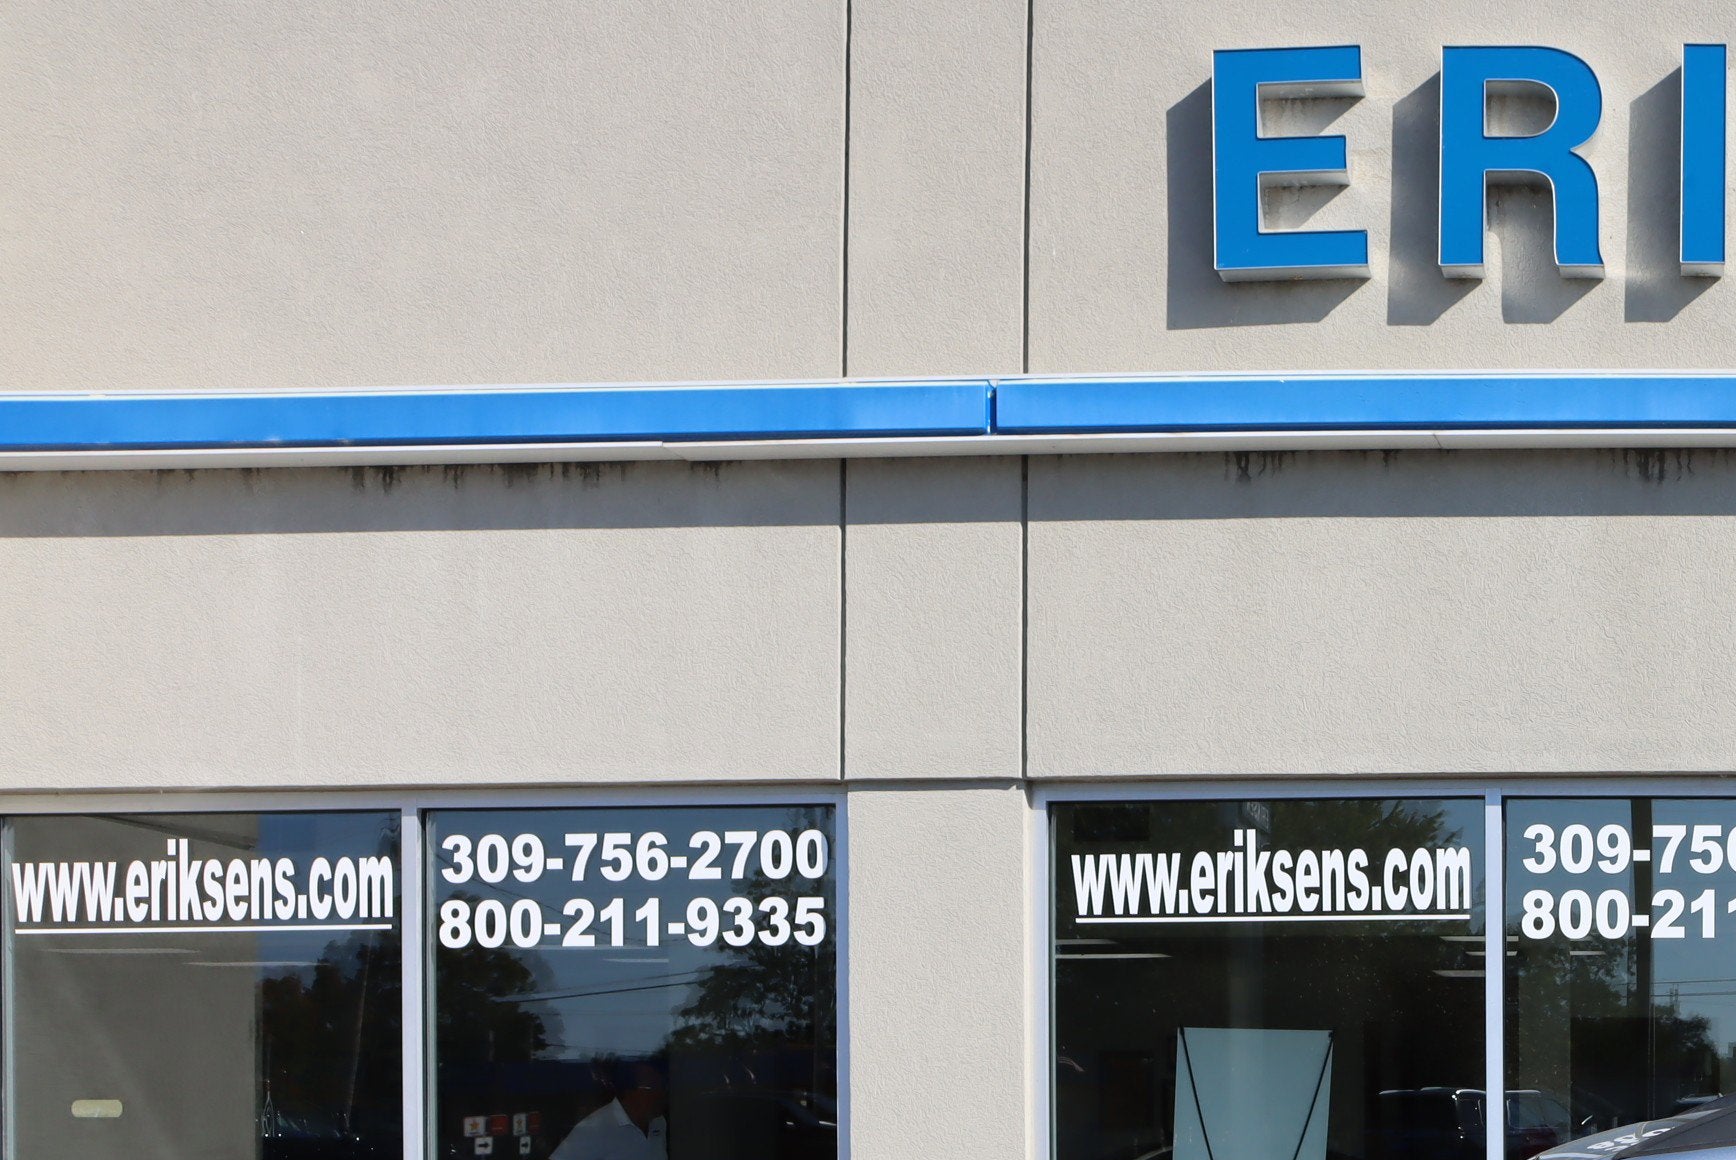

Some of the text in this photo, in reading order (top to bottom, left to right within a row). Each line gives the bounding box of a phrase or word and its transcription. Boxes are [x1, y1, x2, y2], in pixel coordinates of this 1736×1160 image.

[12, 838, 393, 923] www.eriksens.com
[441, 829, 825, 884] 309-756-2700
[1071, 829, 1470, 916] www.eriksens.com
[439, 896, 825, 949] 800-211-9335
